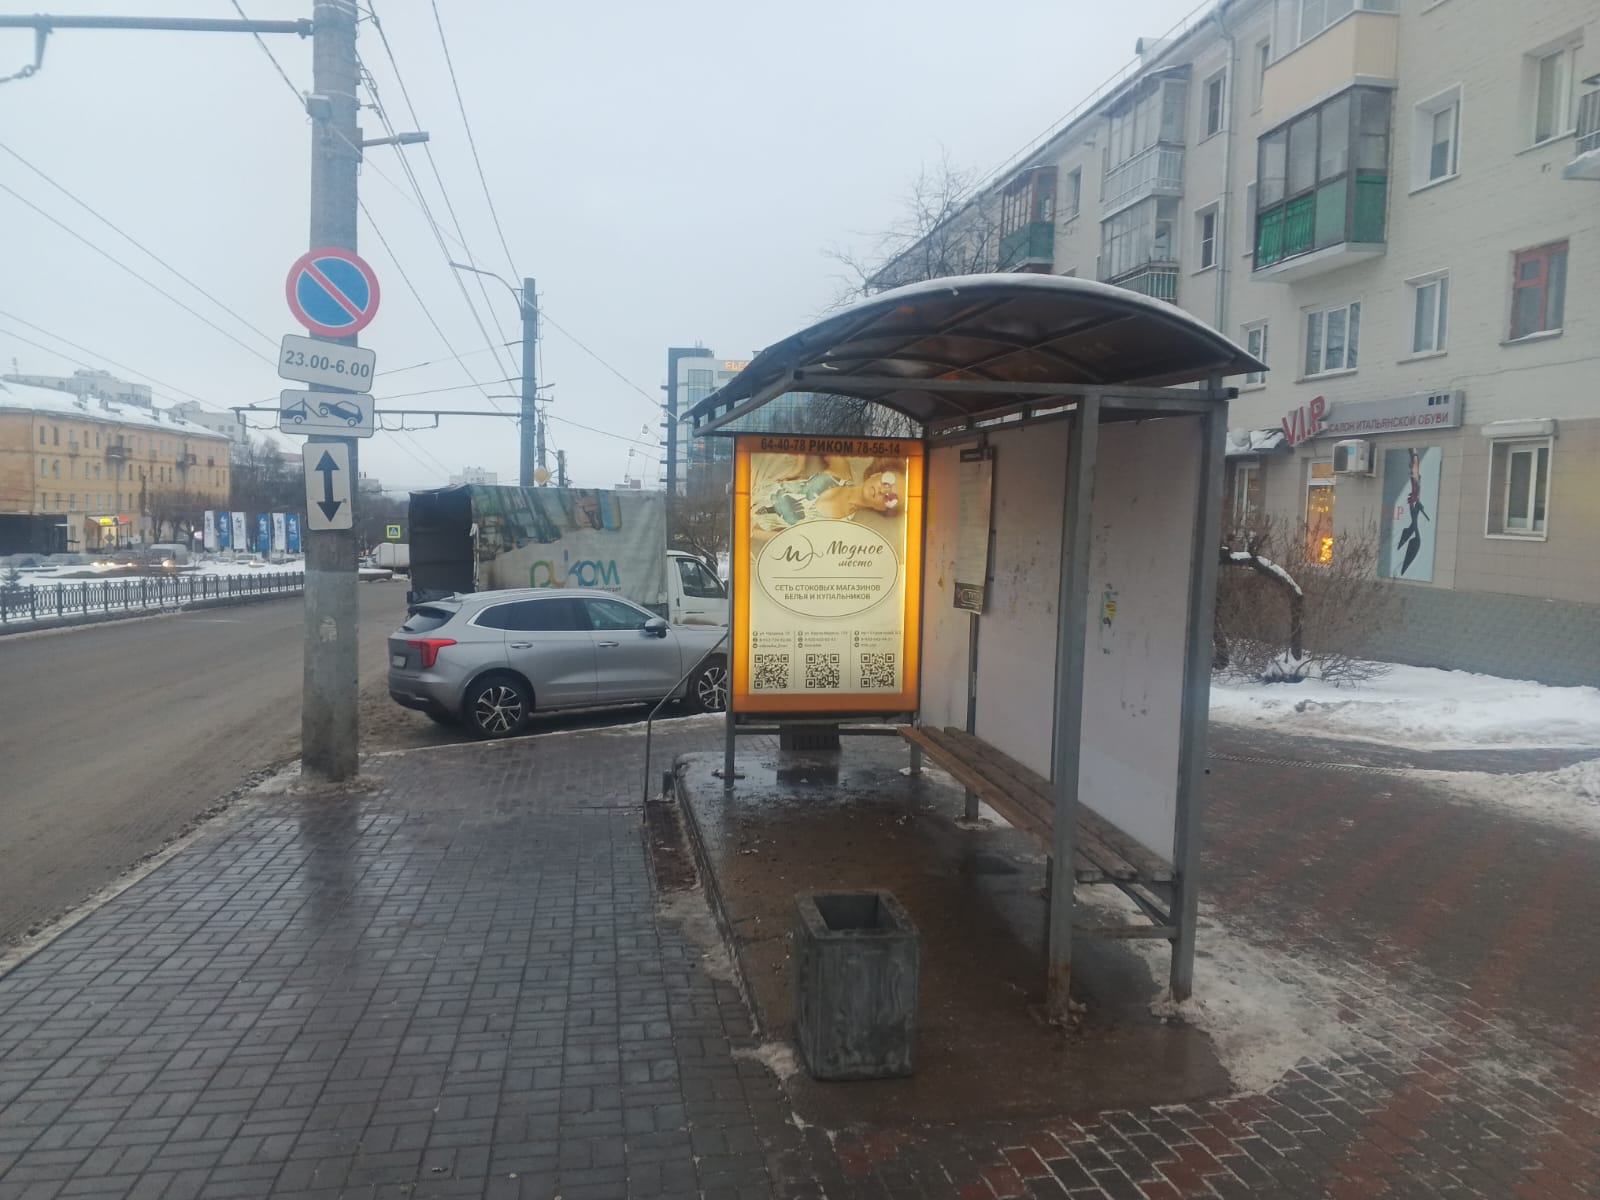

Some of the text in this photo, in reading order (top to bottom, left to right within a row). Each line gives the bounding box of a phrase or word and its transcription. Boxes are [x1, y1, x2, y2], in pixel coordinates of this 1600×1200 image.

[285, 349, 370, 378] 23.00-6.00
[1327, 411, 1449, 434] САЛОН ИТАЛЬЯНСКОЙ ОБУВИ
[761, 438, 806, 451] 64-40-78
[808, 439, 854, 454] РИКОМ
[826, 540, 884, 560] Модное
[838, 558, 873, 568] место
[774, 584, 881, 592] СЕТЬ СТОКОВЫХ МАГАЗИНОВ
[784, 593, 871, 601] БЕЛЬЯ И КУПАЛЬНИКОВ
